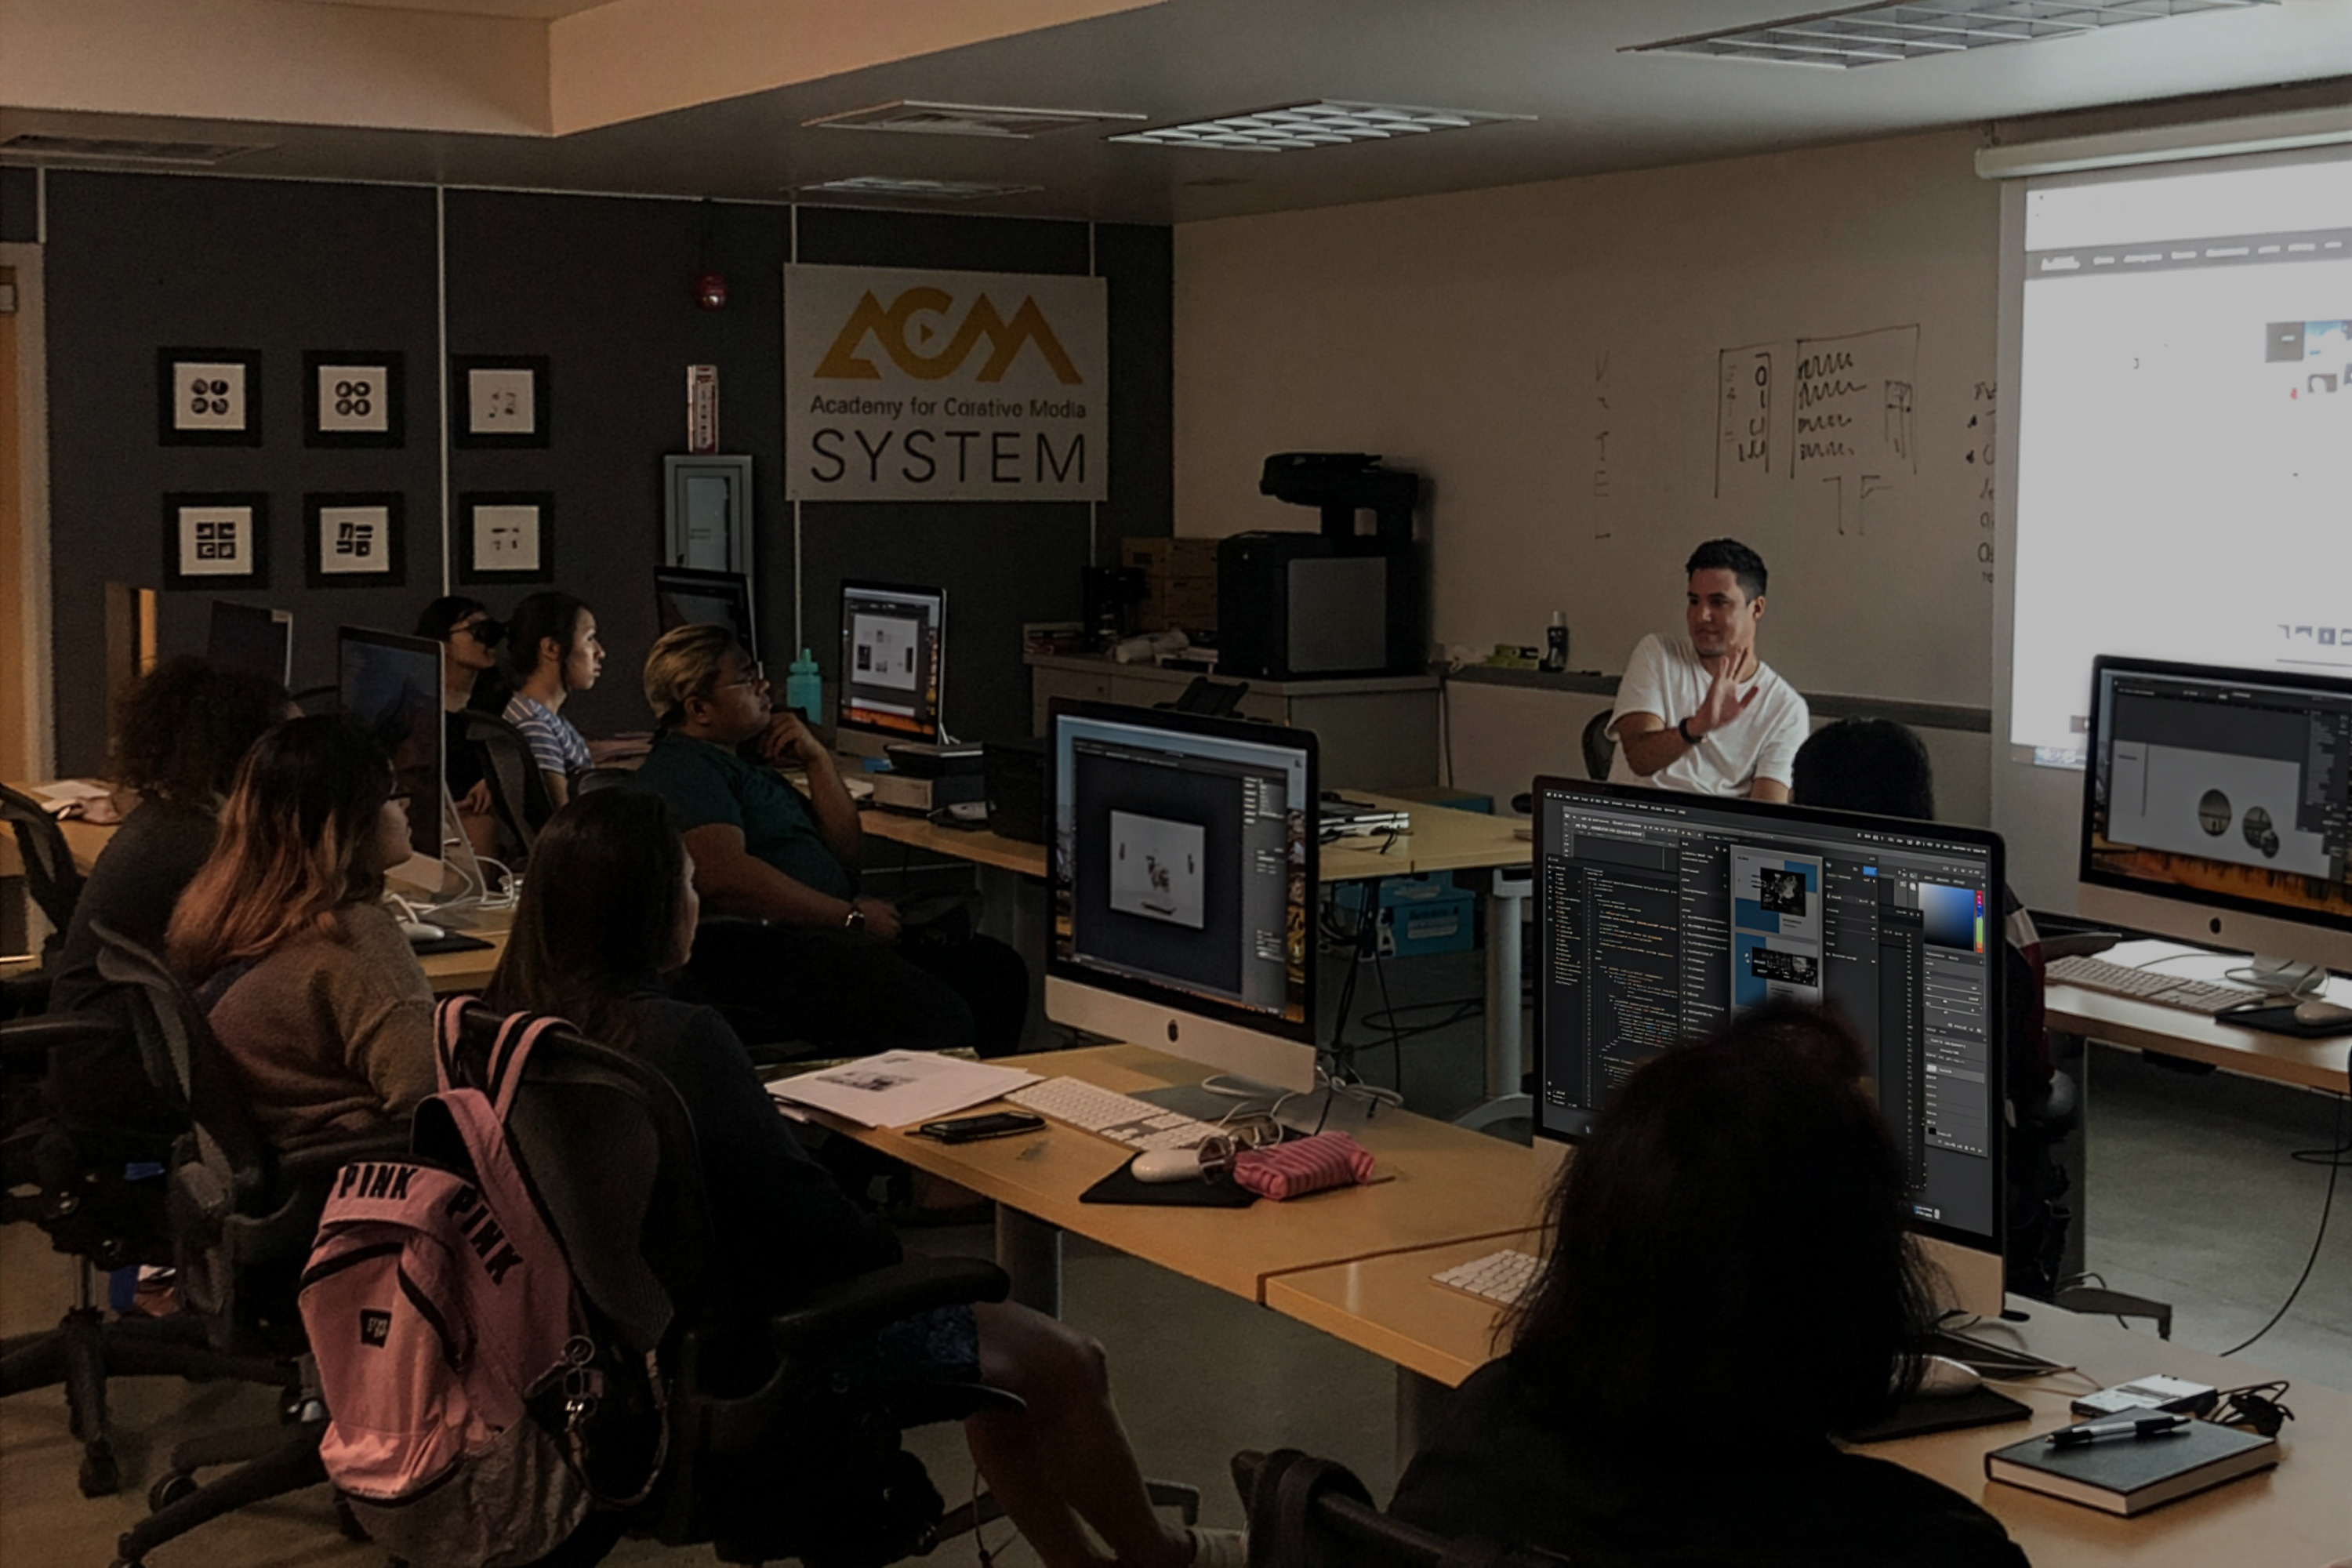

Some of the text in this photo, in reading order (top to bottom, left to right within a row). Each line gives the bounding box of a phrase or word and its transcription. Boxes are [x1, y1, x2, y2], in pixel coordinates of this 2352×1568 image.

[813, 285, 1083, 385] ACM
[810, 395, 903, 421] Academy
[909, 395, 938, 416] for
[811, 428, 1085, 484] SYSTEM
[338, 1165, 419, 1200] PINK
[445, 1185, 524, 1285] PINK
